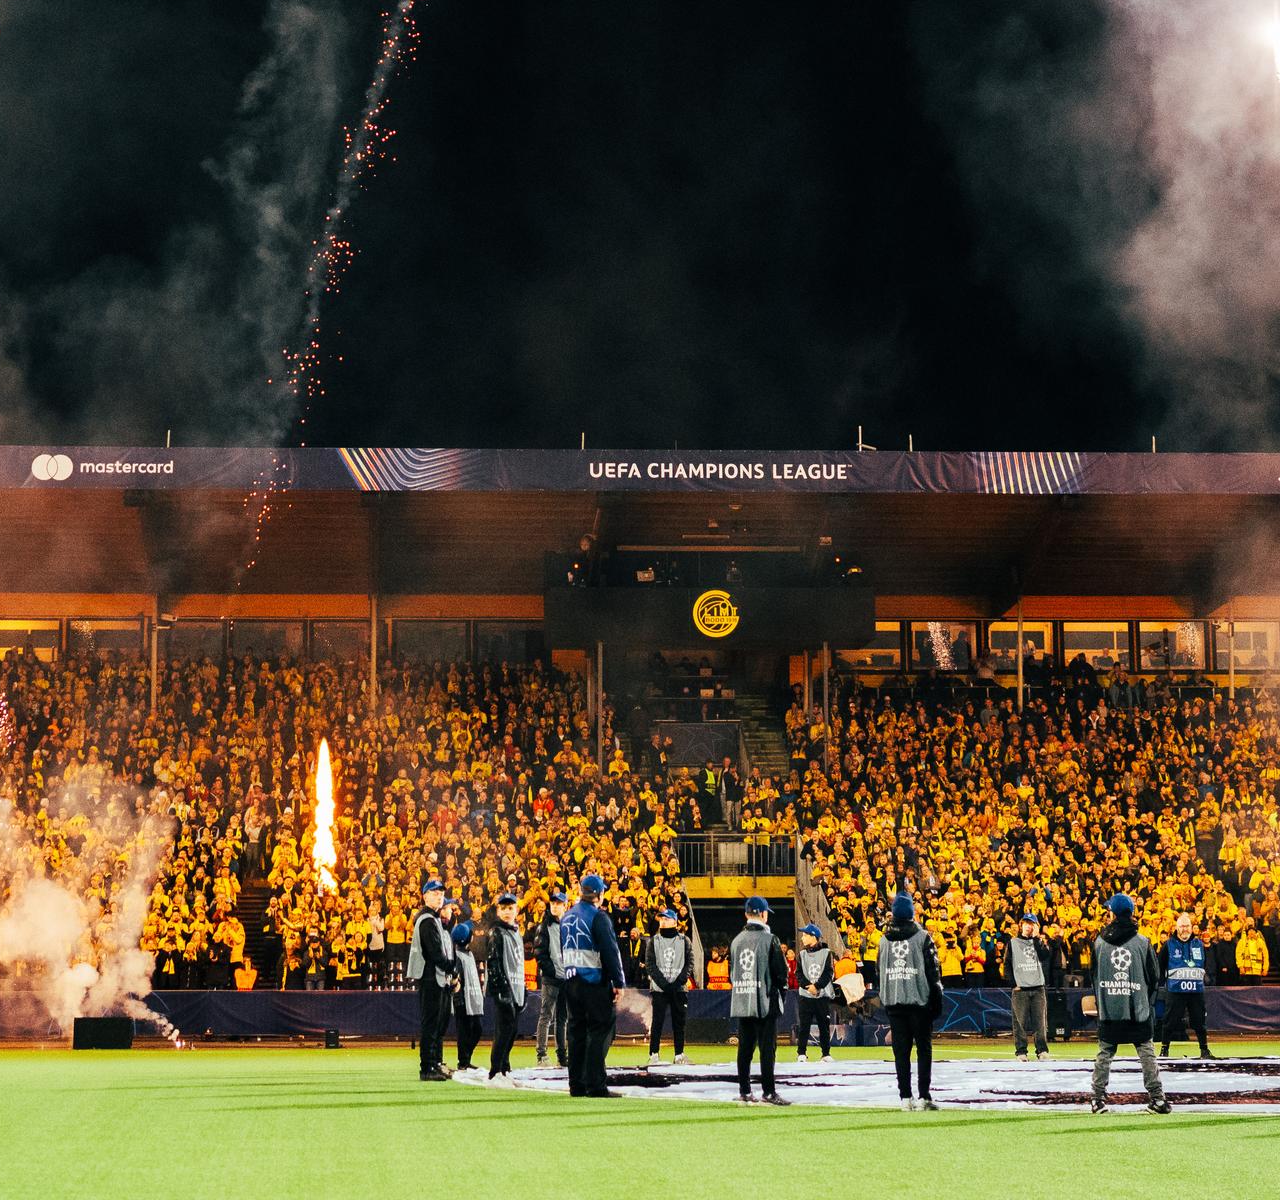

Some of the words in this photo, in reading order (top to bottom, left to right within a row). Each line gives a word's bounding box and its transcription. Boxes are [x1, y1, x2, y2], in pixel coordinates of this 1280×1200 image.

[80, 460, 174, 474] mastercard
[589, 462, 641, 478] UEFA
[647, 462, 765, 479] CHAMPIONS
[1180, 981, 1197, 991] 001
